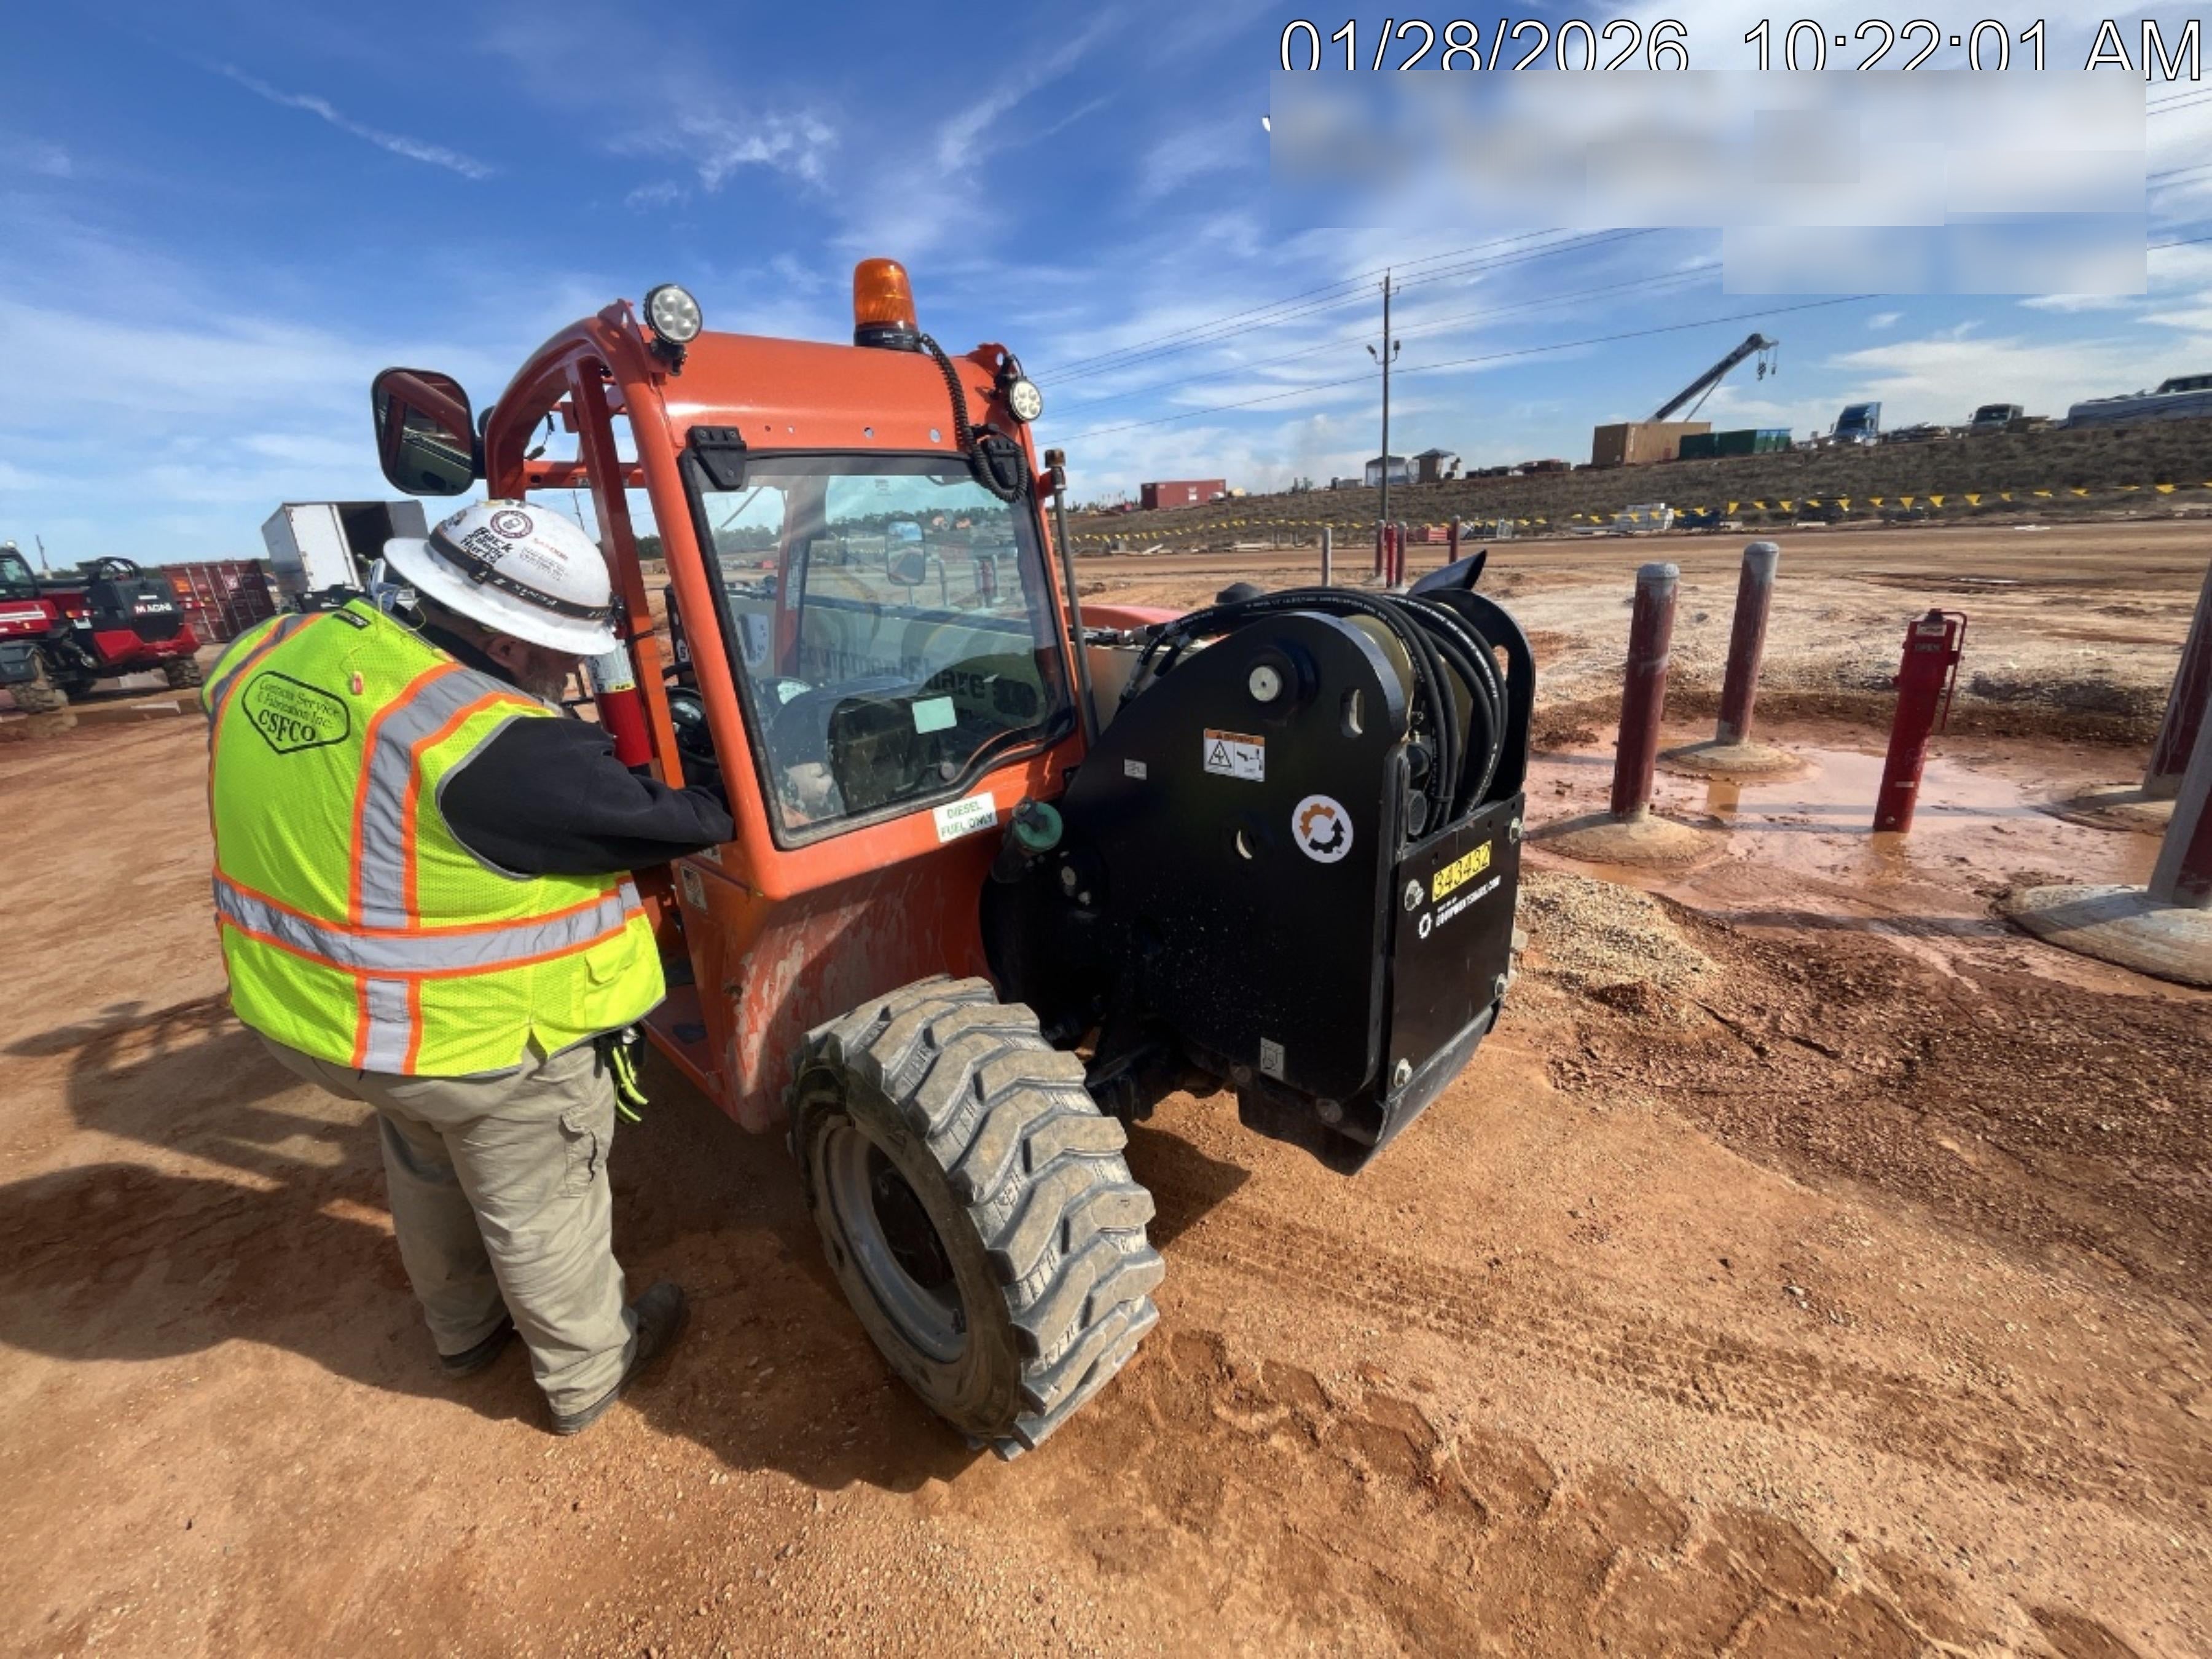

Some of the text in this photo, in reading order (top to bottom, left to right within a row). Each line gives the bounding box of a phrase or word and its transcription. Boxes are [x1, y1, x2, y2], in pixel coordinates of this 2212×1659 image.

[259, 709, 316, 742] CSFCO
[947, 801, 983, 818] DIESEL
[941, 812, 993, 837] FUEL ONLY
[1435, 842, 1491, 898] 343432
